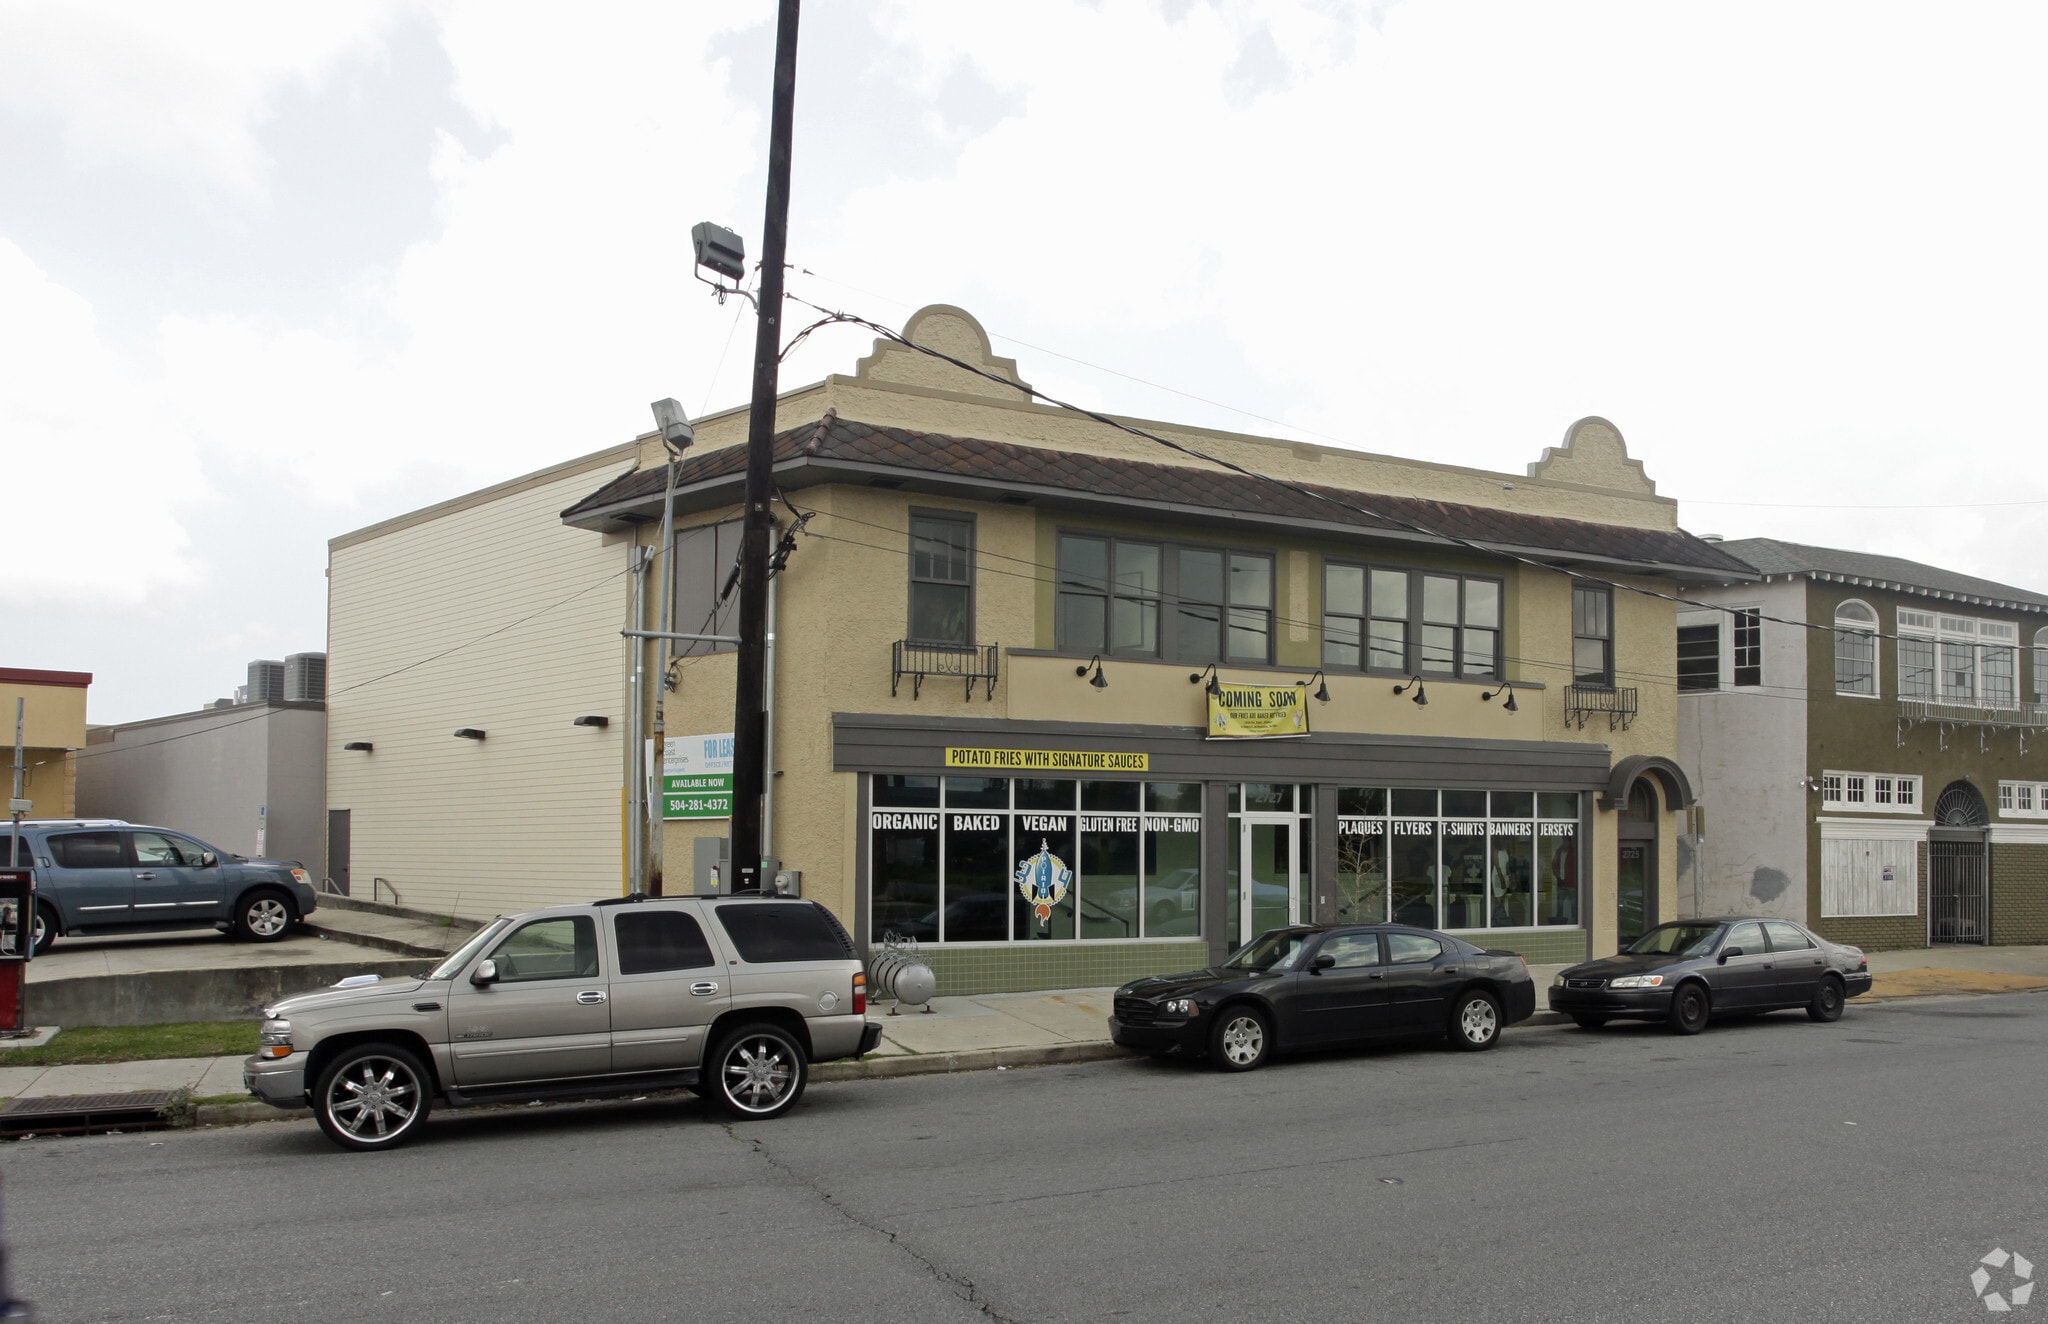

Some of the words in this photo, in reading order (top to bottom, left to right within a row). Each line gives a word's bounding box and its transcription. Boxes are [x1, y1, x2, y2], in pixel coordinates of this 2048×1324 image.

[1218, 691, 1262, 708] COMING
[1269, 691, 1297, 707] SOON
[704, 739, 718, 759] FOR
[719, 738, 735, 758] LEAS
[952, 749, 991, 764] POTATO
[994, 751, 1021, 765] FRIES
[1024, 752, 1049, 766] WITH
[1052, 752, 1105, 767] SIGNATURE
[1108, 754, 1143, 768] SAUCES
[671, 779, 707, 788] AVAILABLE
[708, 778, 725, 787] NOW
[670, 799, 728, 811] 504-281-4372
[872, 813, 938, 830] ORGANIC
[953, 815, 1000, 831] BAKED
[1022, 816, 1067, 832] VEGAN
[1080, 817, 1114, 832] GLUTEN
[1116, 817, 1137, 832] FREE
[1144, 818, 1200, 833] NON-GMO
[1339, 821, 1383, 835] PLAQUES
[1394, 821, 1432, 835] FLYERS
[1441, 822, 1485, 836] T-SHIRTS
[1490, 823, 1532, 836] BANNERS
[1540, 823, 1574, 836] JERSEYS
[1622, 850, 1640, 859] 2725
